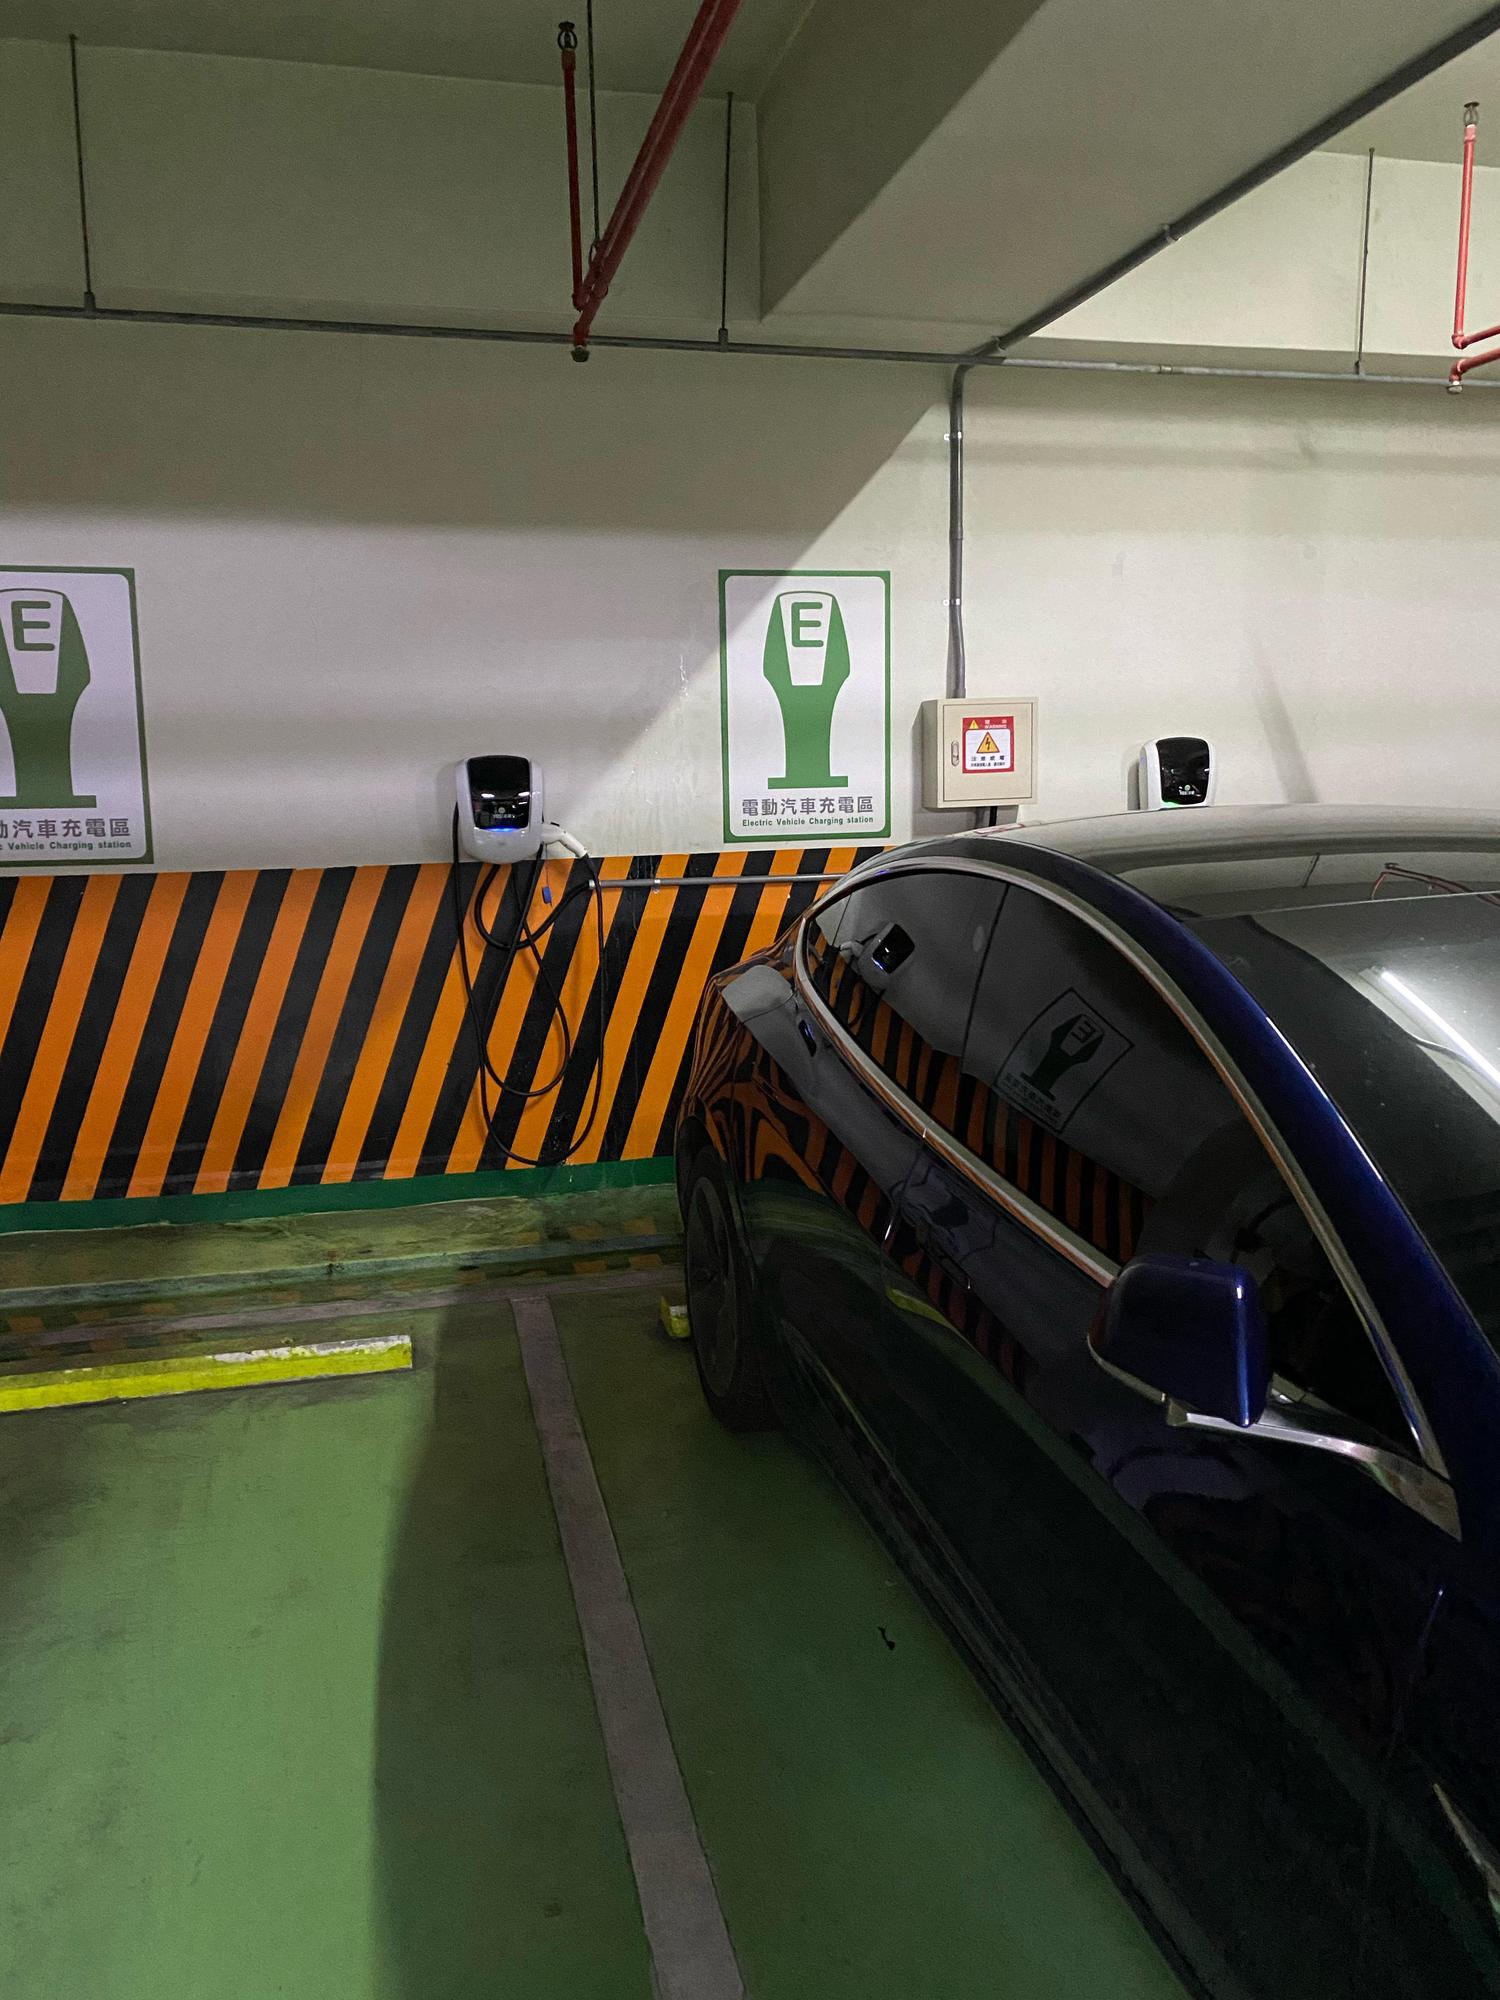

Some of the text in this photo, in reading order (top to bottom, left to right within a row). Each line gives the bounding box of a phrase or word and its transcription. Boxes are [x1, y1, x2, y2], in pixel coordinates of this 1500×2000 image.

[11, 600, 56, 652] E
[791, 601, 824, 648] E
[742, 795, 873, 817] 電動汽車充電區
[742, 816, 874, 827] Electric Vehicle Charging station
[7, 842, 45, 850] Vehicle
[49, 841, 94, 851] Charging
[98, 840, 132, 849] station
